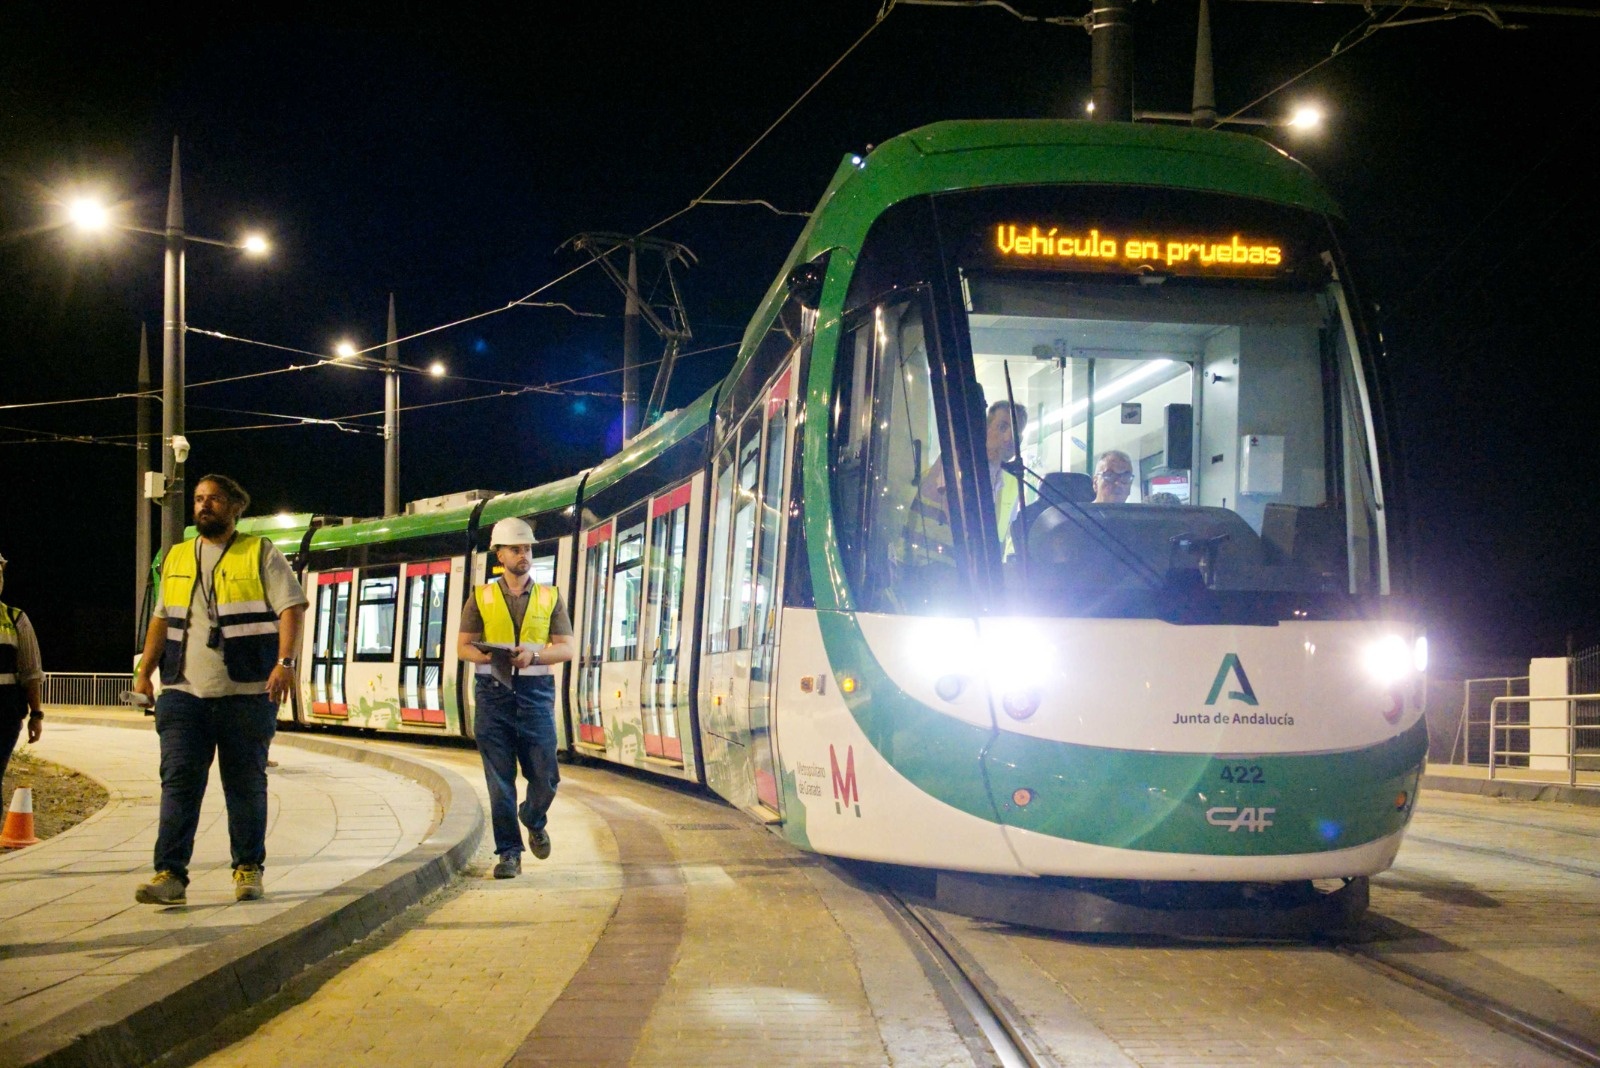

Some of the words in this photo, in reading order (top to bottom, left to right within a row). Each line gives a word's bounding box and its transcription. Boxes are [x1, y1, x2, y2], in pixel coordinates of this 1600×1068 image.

[997, 225, 1117, 258] Vehículo
[1125, 240, 1159, 259] en
[1166, 235, 1282, 265] pruebas
[1173, 712, 1211, 725] Junta
[1213, 713, 1230, 725] de
[1232, 713, 1295, 726] Andalucía
[1219, 765, 1266, 784] 422
[1206, 806, 1277, 832] CAF
